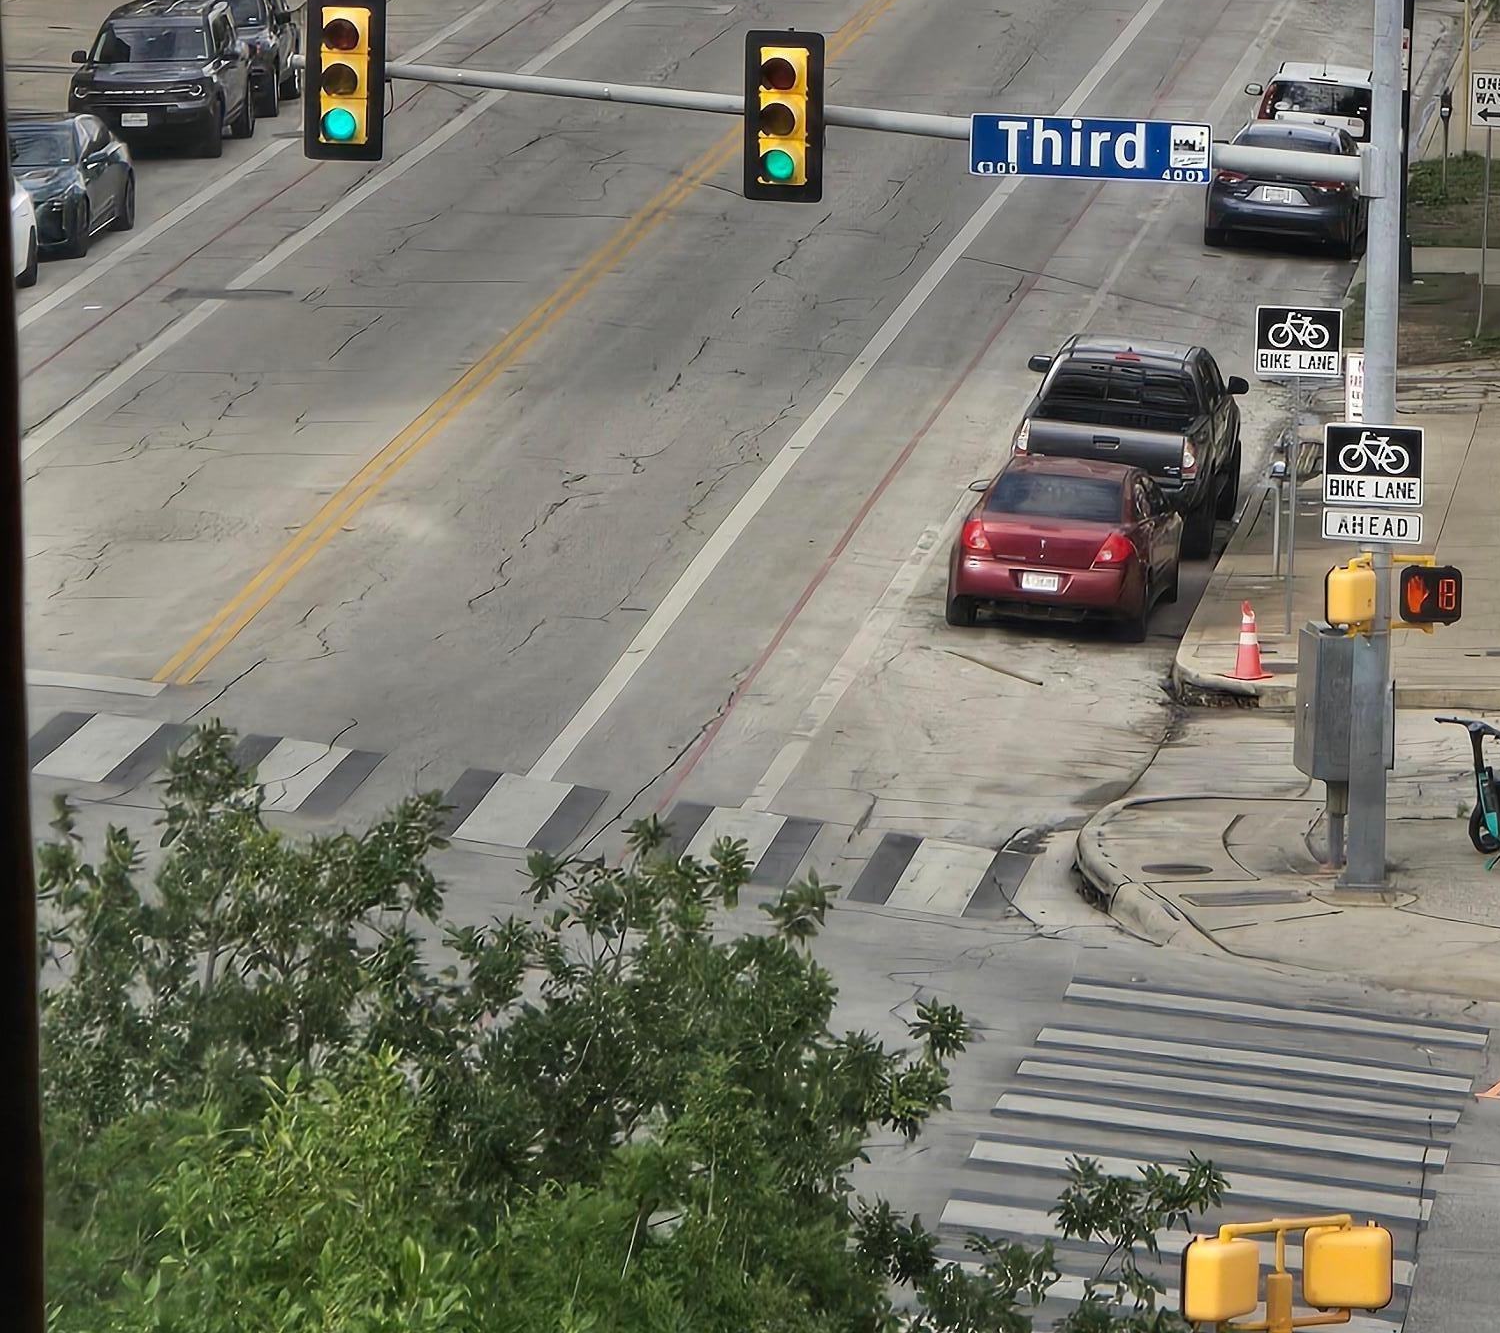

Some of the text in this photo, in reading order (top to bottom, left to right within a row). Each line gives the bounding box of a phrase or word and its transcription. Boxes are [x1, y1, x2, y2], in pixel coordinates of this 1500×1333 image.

[998, 118, 1147, 169] Third
[1162, 169, 1196, 182] 400
[1260, 353, 1335, 371] BIKE LANE
[1329, 479, 1416, 500] BIKE LANE
[1338, 516, 1408, 538] AHEAD
